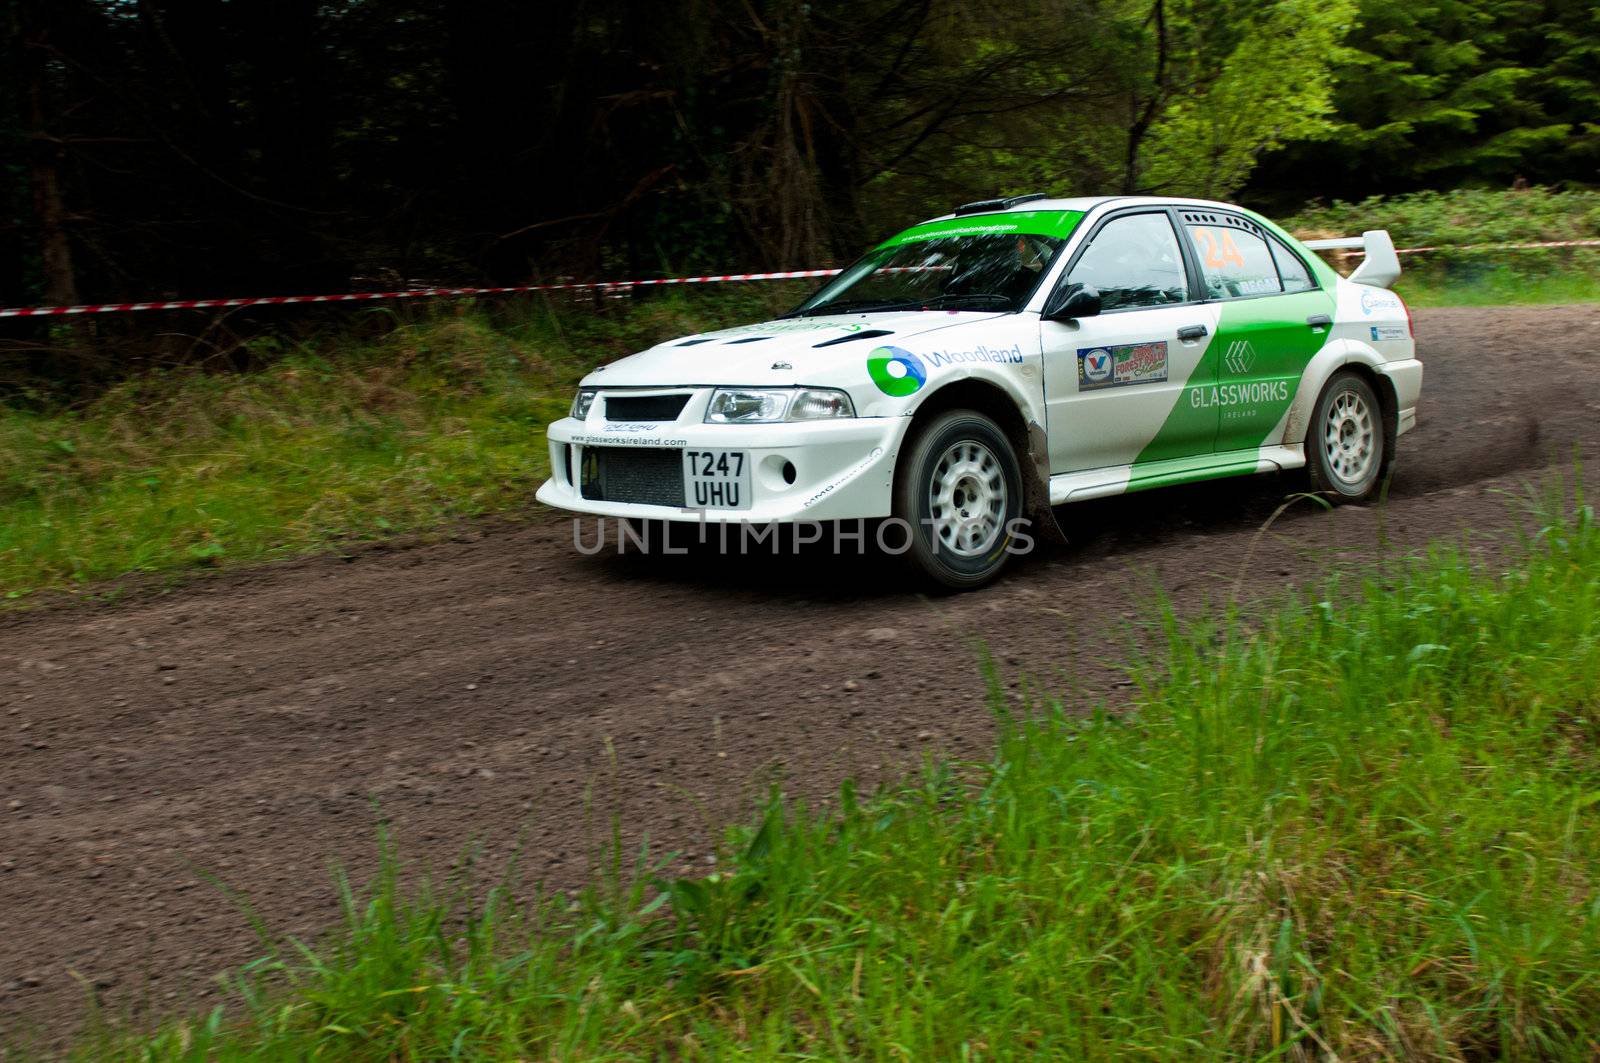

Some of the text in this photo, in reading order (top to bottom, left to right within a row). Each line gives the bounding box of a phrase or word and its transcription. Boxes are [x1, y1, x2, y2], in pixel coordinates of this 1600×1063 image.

[1194, 228, 1245, 269] 24
[923, 344, 1023, 368] Woodland
[1115, 358, 1141, 376] FOREST
[1191, 382, 1288, 408] GLASSWORKS
[1224, 410, 1257, 418] IRELAND
[571, 434, 687, 446] www.glassworksireland.com
[687, 452, 744, 477] T247
[695, 481, 739, 506] UHU
